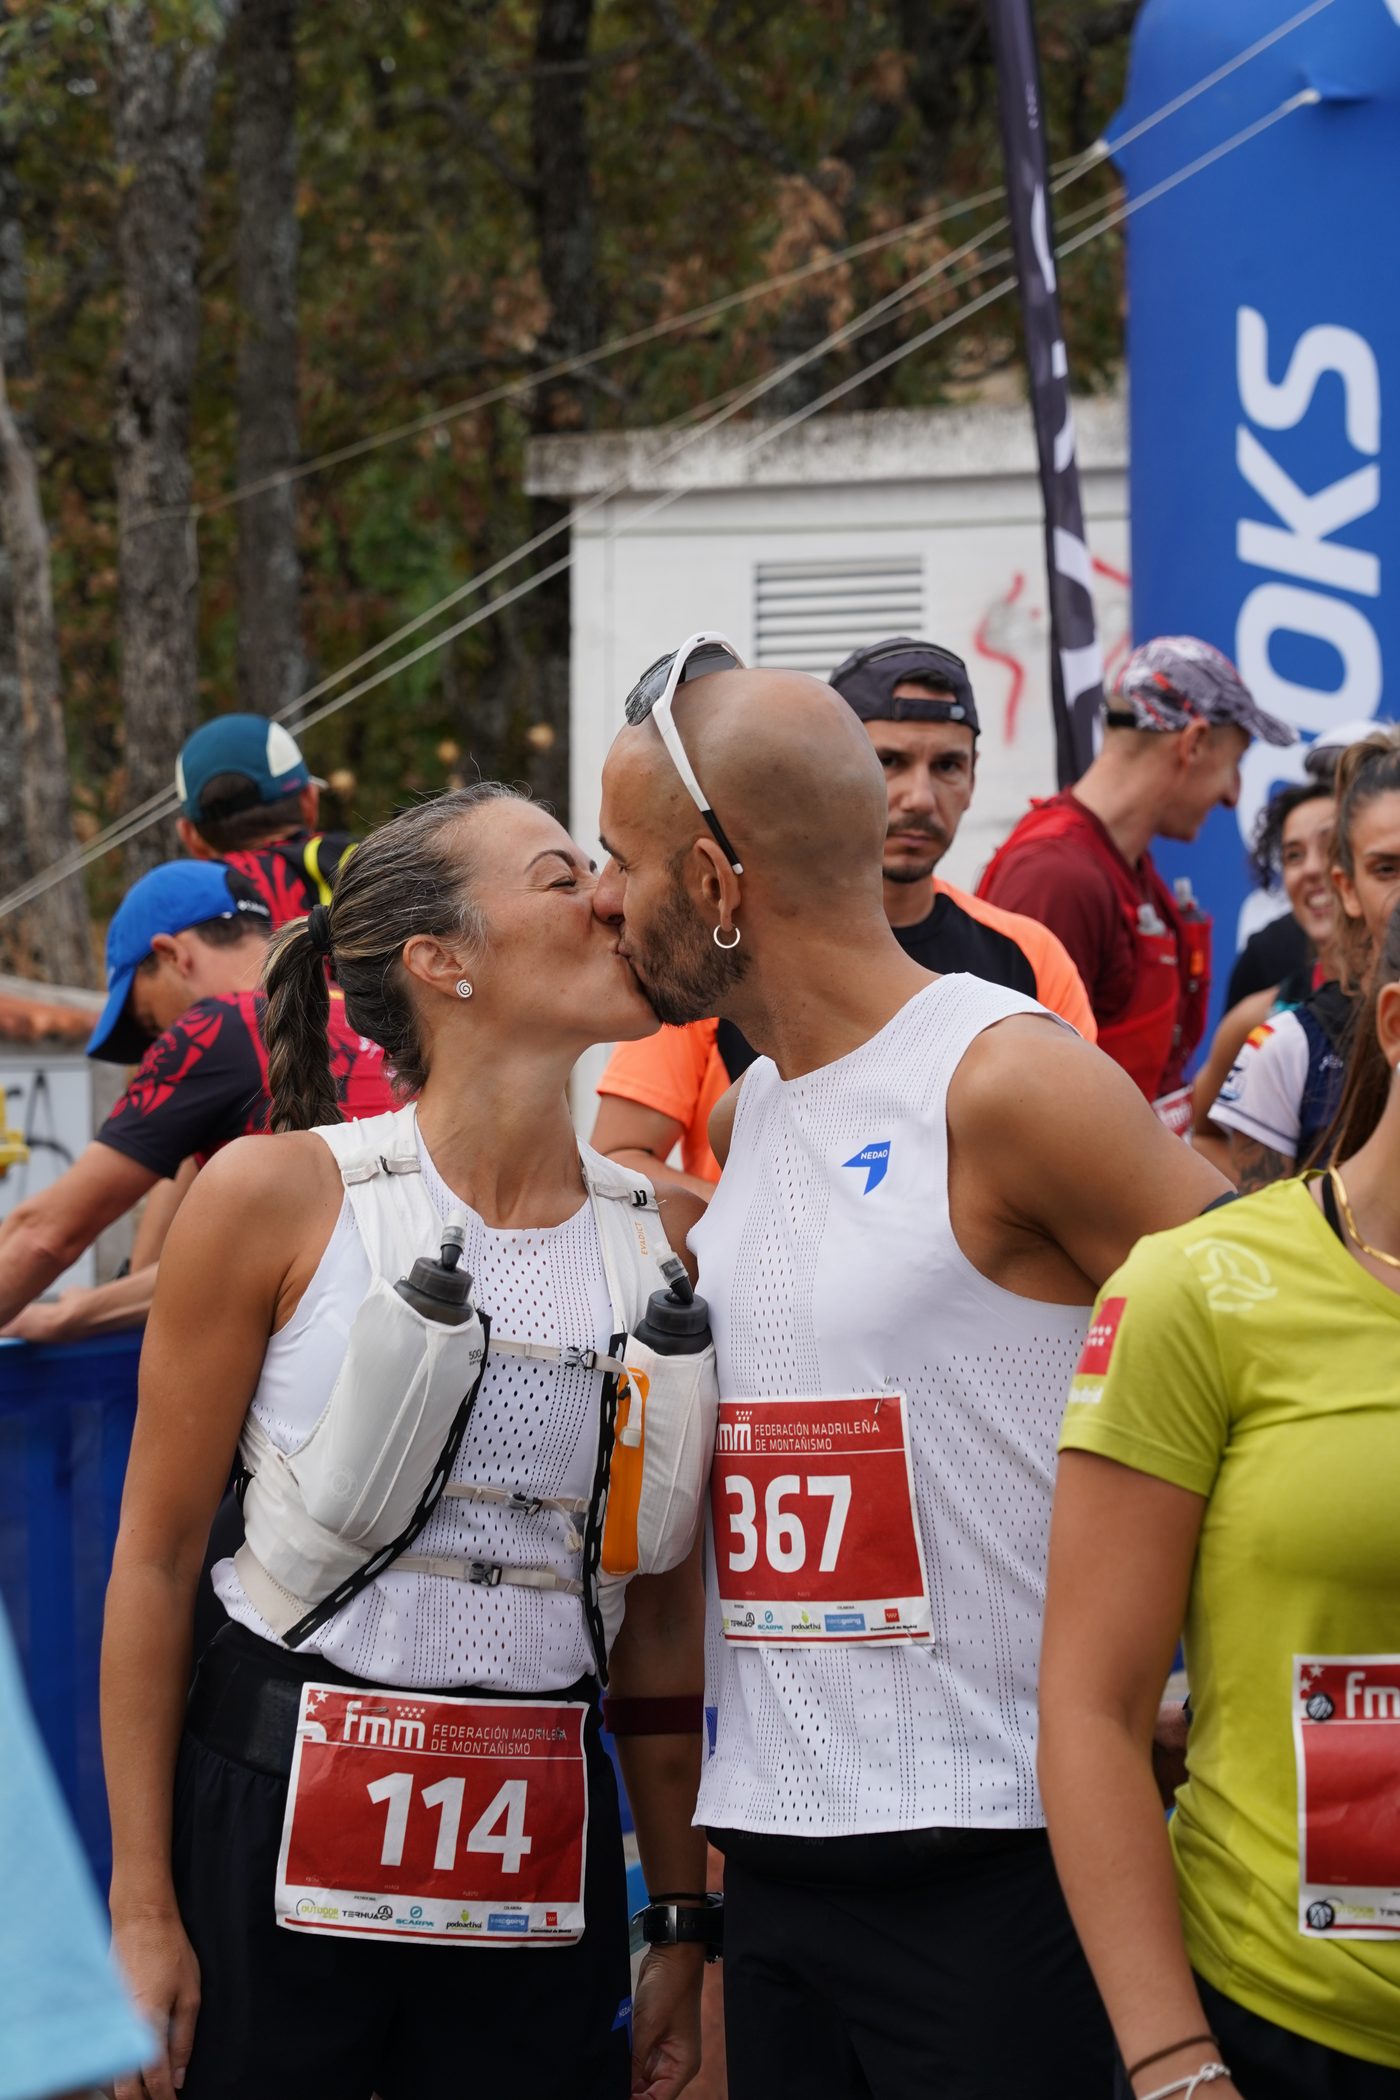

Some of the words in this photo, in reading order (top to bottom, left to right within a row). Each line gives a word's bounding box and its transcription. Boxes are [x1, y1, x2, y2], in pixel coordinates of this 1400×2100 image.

[1236, 305, 1382, 952] OKS
[860, 1149, 888, 1160] NEDAO
[635, 1220, 649, 1256] EVADICT
[716, 1423, 751, 1451] mm
[754, 1421, 810, 1437] FEDERACIÓN
[812, 1419, 880, 1436] MADRILEÑA
[755, 1439, 767, 1451] DE
[769, 1436, 832, 1451] MONTAÑISMO
[724, 1474, 853, 1574] 367
[343, 1700, 426, 1750] fmm
[432, 1722, 509, 1740] FEDERACIÓN
[431, 1738, 448, 1752] DE
[451, 1740, 531, 1756] MONTAÑISMO
[366, 1771, 532, 1874] 114
